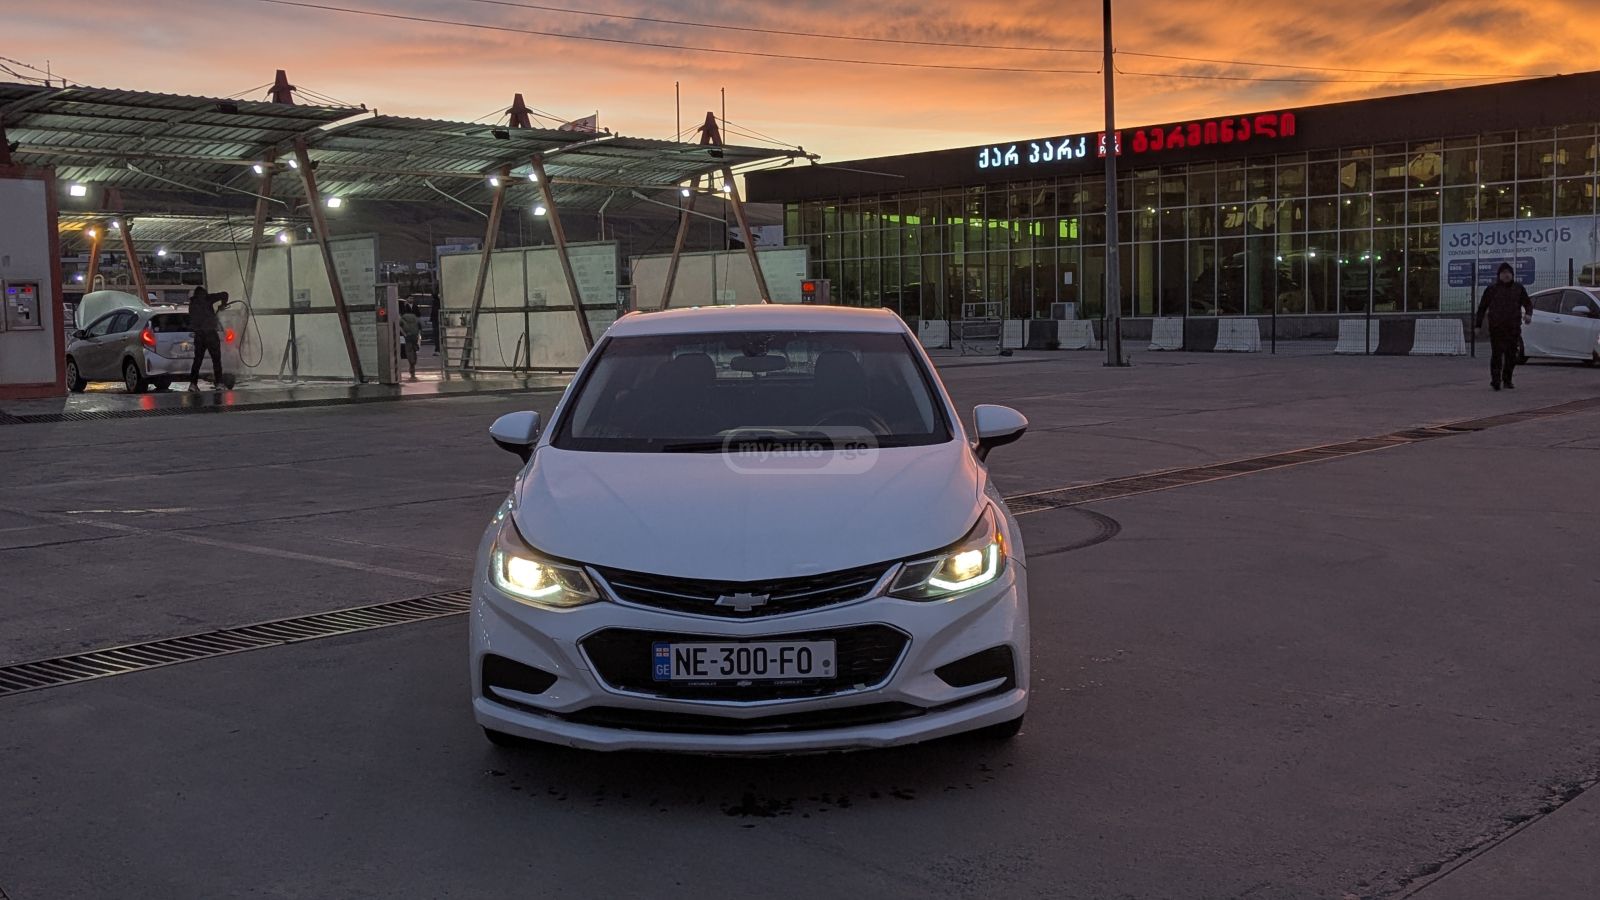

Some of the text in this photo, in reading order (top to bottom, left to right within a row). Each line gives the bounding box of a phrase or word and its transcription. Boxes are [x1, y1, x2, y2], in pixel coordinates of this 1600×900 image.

[1132, 112, 1295, 153] ტერმინალი
[978, 136, 1086, 168] ქარ პარკ
[655, 664, 670, 676] GE
[675, 646, 813, 676] NE-300-FO
